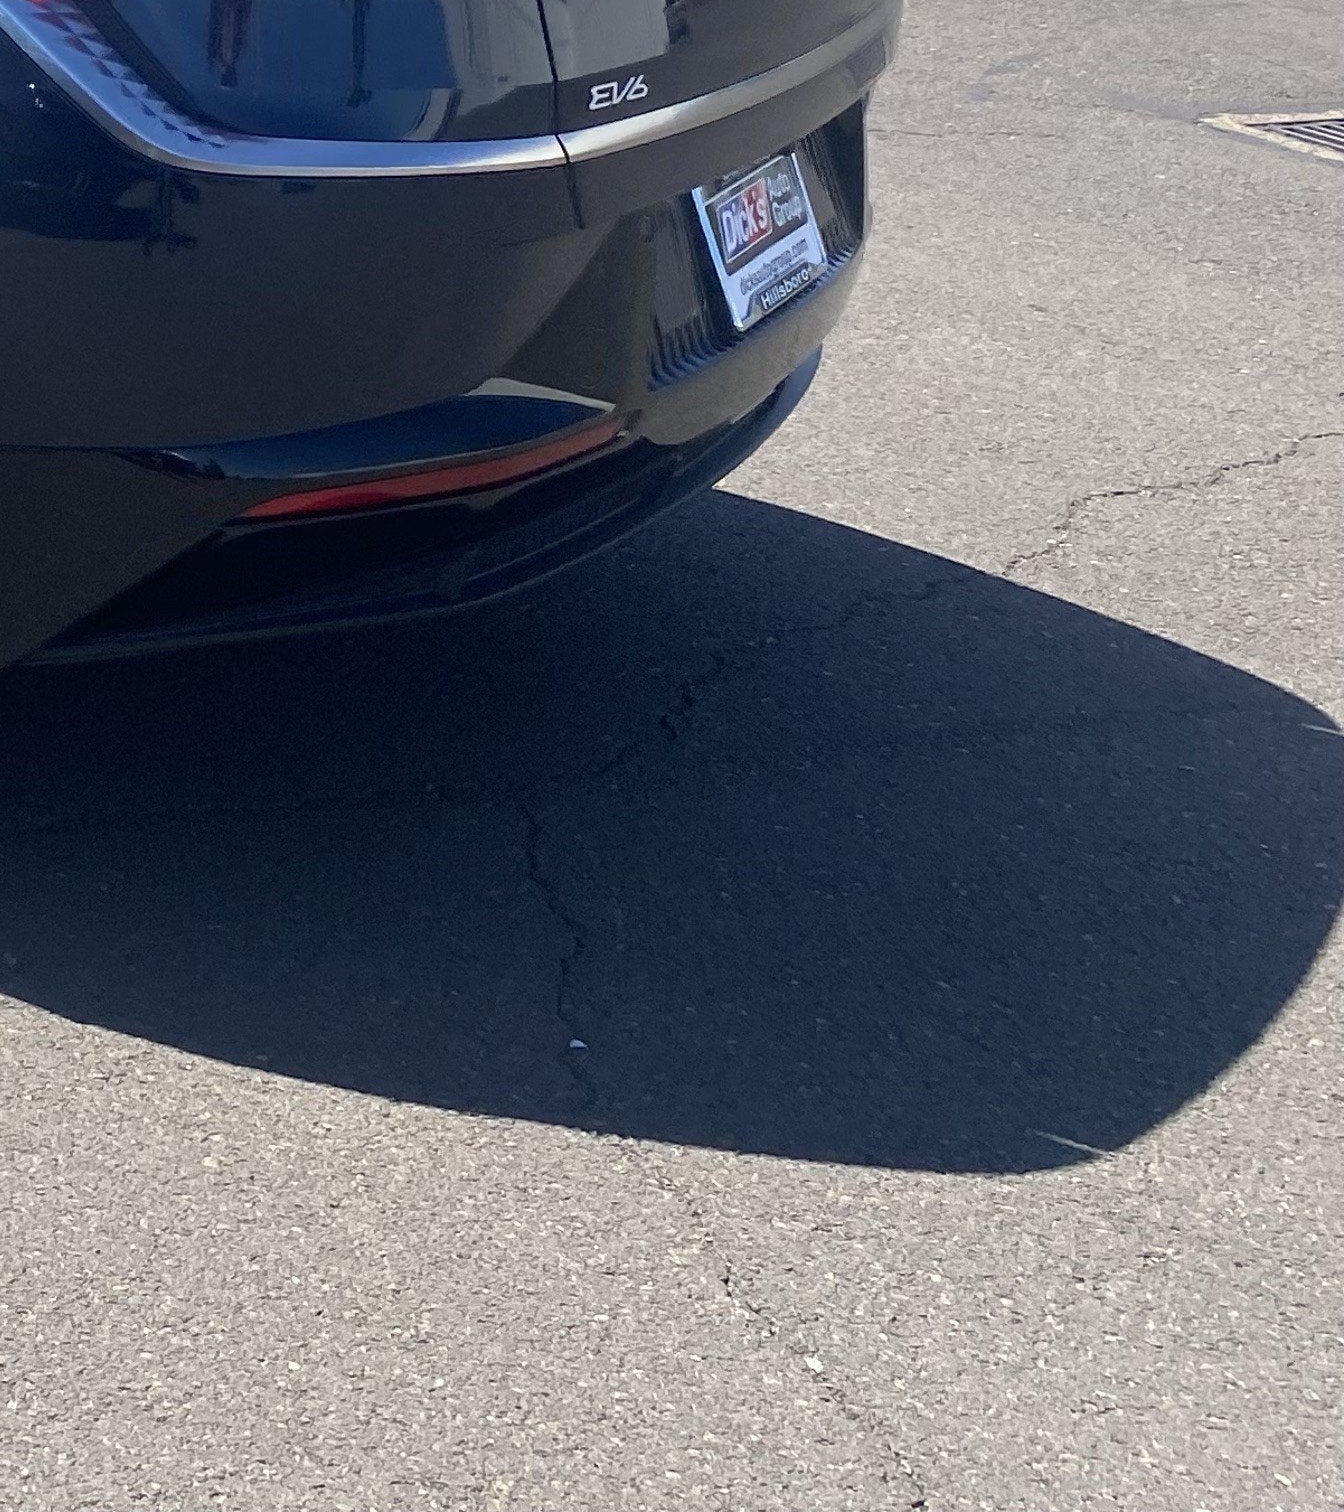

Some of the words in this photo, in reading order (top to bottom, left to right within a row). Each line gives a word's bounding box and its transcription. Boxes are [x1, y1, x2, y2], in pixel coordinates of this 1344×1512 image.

[589, 74, 648, 110] EV6
[772, 196, 802, 227] Group
[761, 268, 809, 310] Hillsboro
